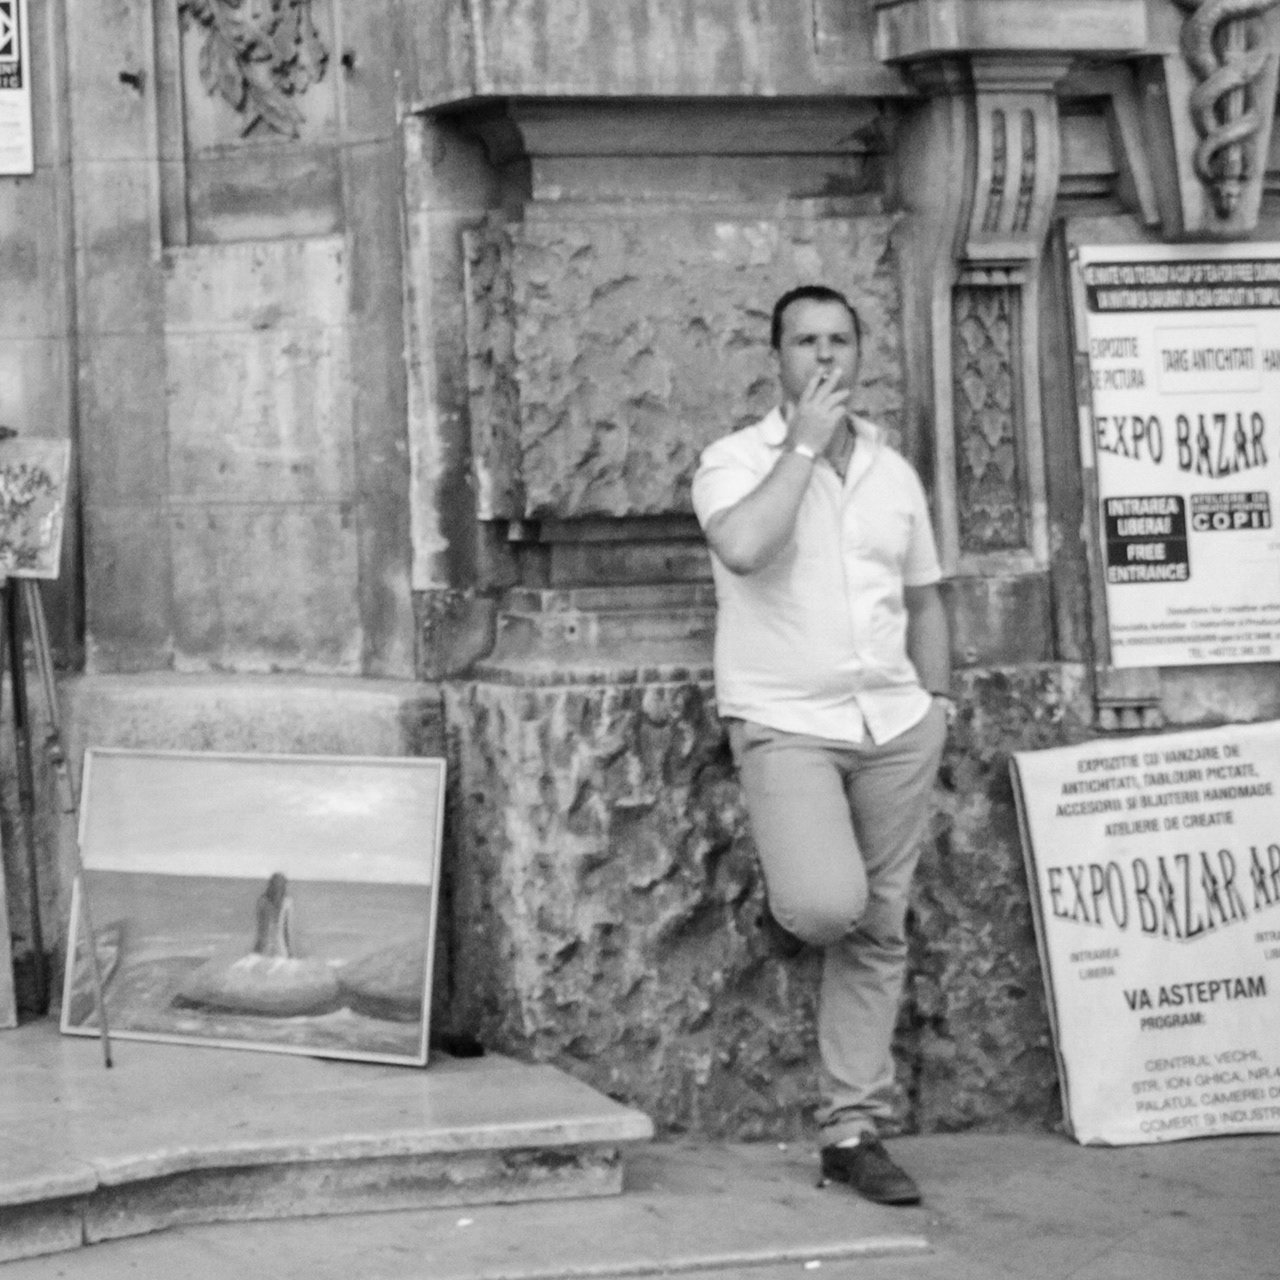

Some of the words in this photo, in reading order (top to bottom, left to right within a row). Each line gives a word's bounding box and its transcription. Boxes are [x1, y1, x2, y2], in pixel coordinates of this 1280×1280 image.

[1162, 349, 1189, 372] TARG
[1095, 415, 1163, 465] EXPO
[1176, 412, 1268, 480] BAZAR
[1108, 497, 1179, 517] INTRAREA
[1192, 511, 1269, 530] COPII
[1127, 543, 1166, 561] FREE
[1108, 562, 1188, 582] ENTRANCE
[1077, 754, 1139, 773] EXPOZITIE
[1143, 752, 1159, 767] CU
[1163, 746, 1219, 764] VANZARE
[1222, 744, 1239, 759] DE
[1143, 768, 1203, 788] TABLOURI
[1056, 798, 1123, 817] ACCESORII
[1203, 782, 1274, 802] HANDMADE
[1104, 818, 1160, 837] ATELIERE
[1163, 816, 1180, 831] DE
[1183, 810, 1234, 829] CREATIE
[1047, 861, 1128, 929] EXPO
[1132, 849, 1246, 939] BAZAR
[1070, 948, 1120, 963] INTRAREA
[1124, 988, 1153, 1011] VA
[1158, 975, 1267, 1008] ASTEPTAM
[1144, 1054, 1211, 1073] CENTRUL
[1165, 1076, 1191, 1090] ION
[1136, 1096, 1198, 1113] PALATUL
[1139, 1114, 1199, 1133] COMERT
